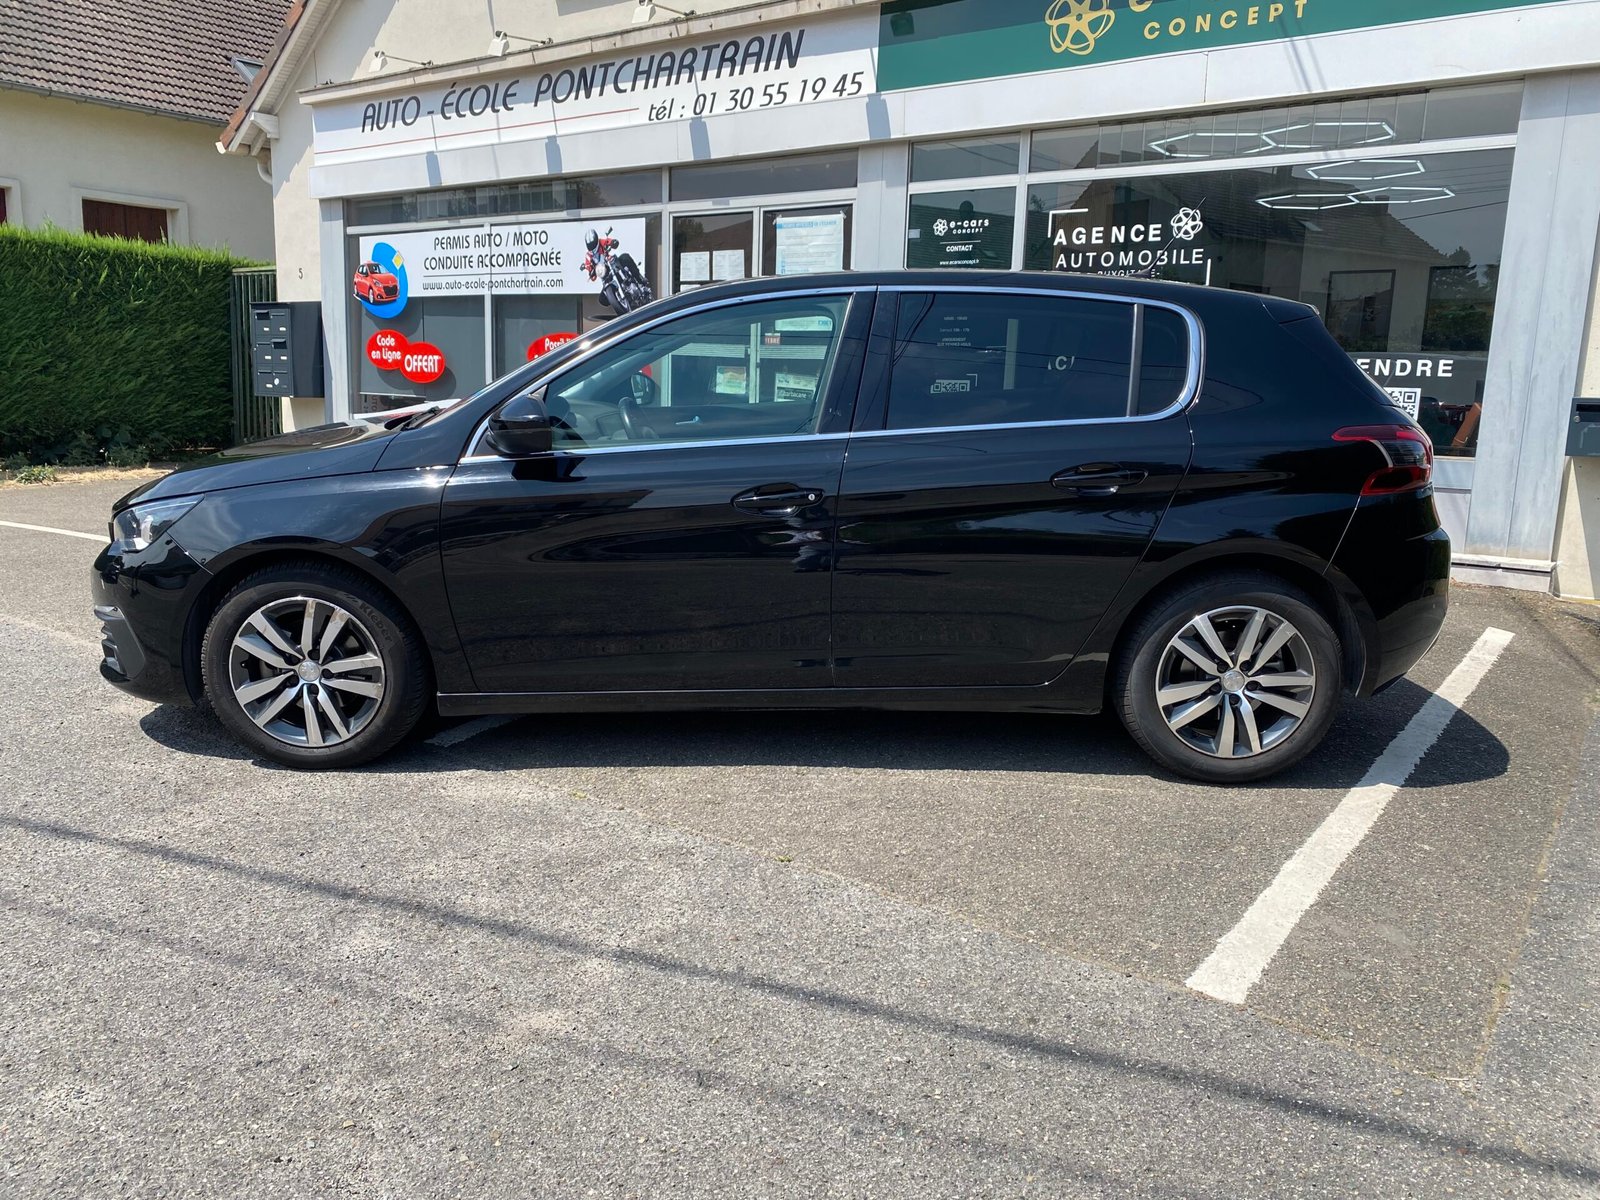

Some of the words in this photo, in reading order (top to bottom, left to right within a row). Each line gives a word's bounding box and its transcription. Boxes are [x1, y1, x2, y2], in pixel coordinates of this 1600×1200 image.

[1143, 0, 1307, 39] CONCEPT
[361, 95, 421, 133] AUTO
[440, 80, 519, 120] ÉCOLE
[534, 29, 805, 107] PONTCHARTRAIN
[648, 99, 673, 121] tél
[693, 92, 716, 115] 01
[725, 88, 752, 112] 30
[759, 82, 788, 107] 55
[800, 77, 826, 102] 19
[832, 71, 864, 97] 45
[949, 218, 989, 228] e-cars
[434, 235, 470, 251] PERMIS
[474, 233, 502, 248] AUTO
[513, 230, 548, 246] MOTO
[1053, 223, 1162, 246] AGENCE
[945, 244, 973, 252] CONTACT
[1056, 248, 1204, 269] AUTOMOBILE
[424, 255, 473, 271] CONDUITE
[478, 248, 561, 269] ACCOMPAGNÉE
[298, 267, 304, 280] 5
[423, 277, 564, 291] www.auto-ecole-pontchartrain.com
[376, 335, 396, 346] Code
[371, 350, 381, 359] en
[382, 348, 402, 363] Ligne
